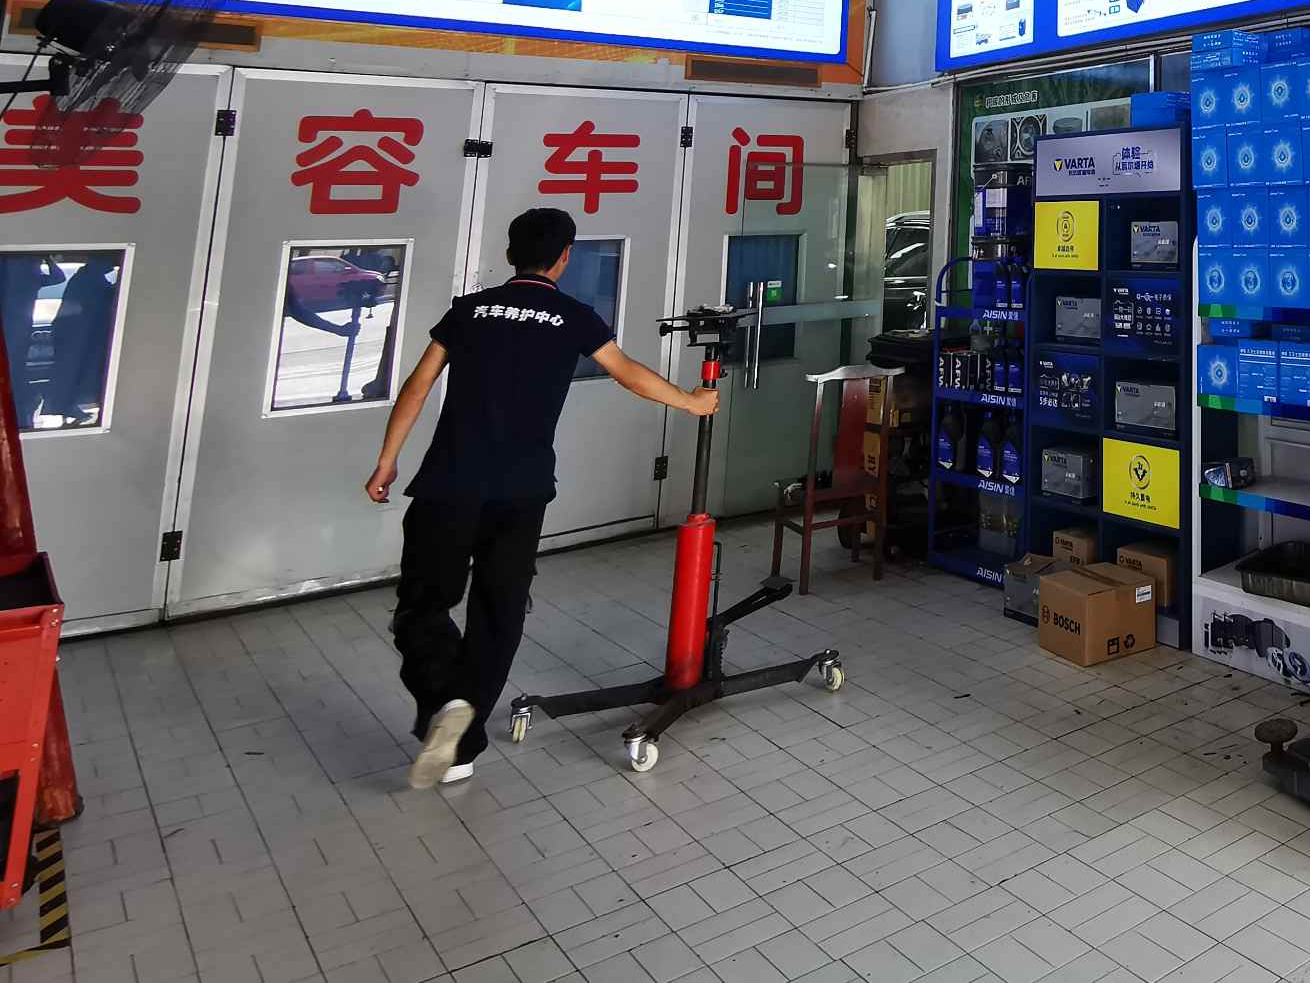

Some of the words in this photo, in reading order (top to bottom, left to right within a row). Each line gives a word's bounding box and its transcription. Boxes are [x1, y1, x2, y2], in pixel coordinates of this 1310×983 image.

[1121, 146, 1141, 160] 体验
[1064, 158, 1095, 170] VARTA
[473, 304, 566, 327] 汽车养护中心
[982, 310, 1007, 320] AISIN
[981, 393, 1005, 405] AISIN
[978, 480, 1003, 493] AISIN
[1053, 612, 1081, 635] BOSCH
